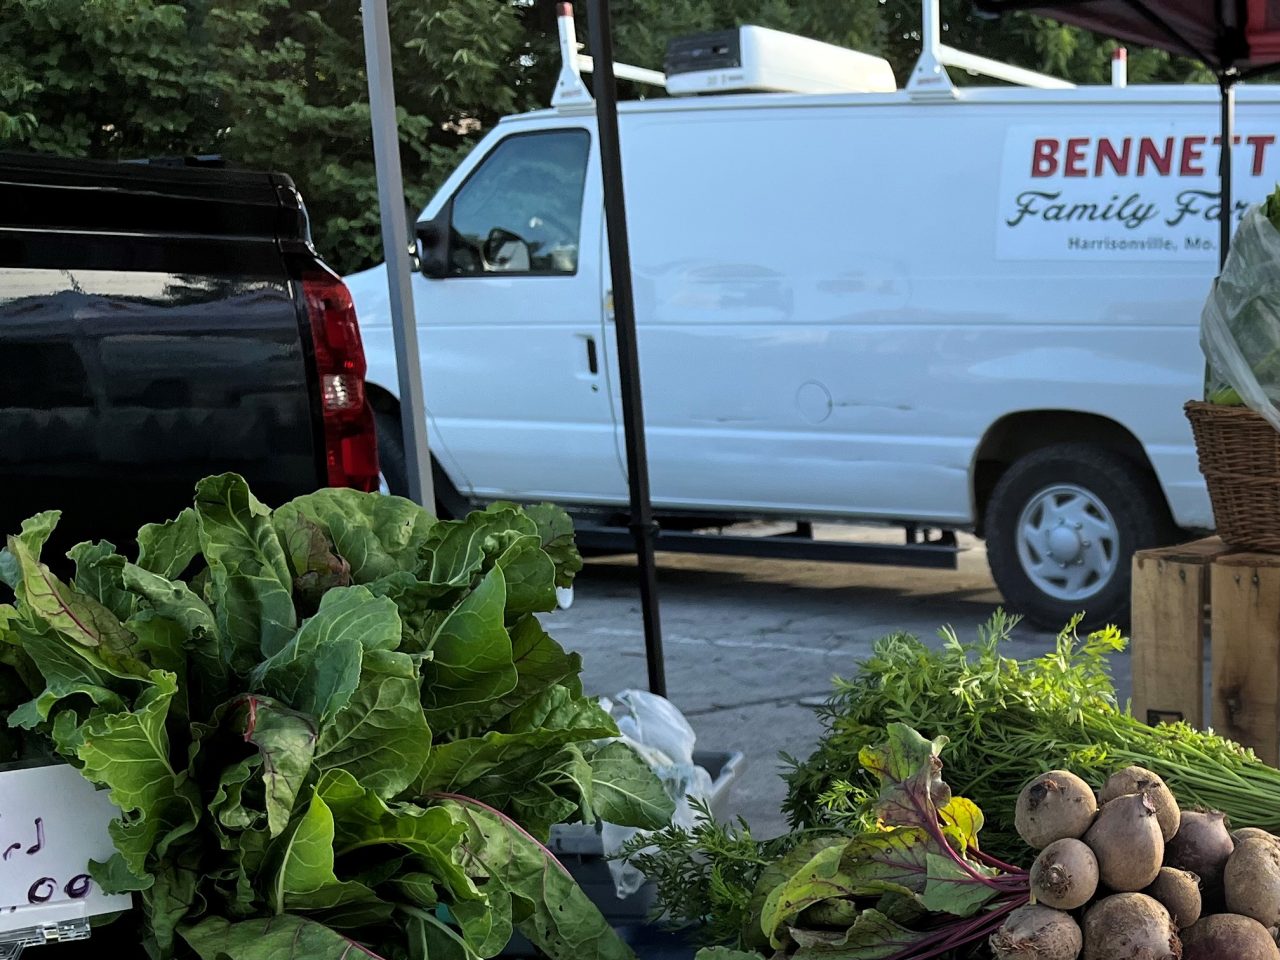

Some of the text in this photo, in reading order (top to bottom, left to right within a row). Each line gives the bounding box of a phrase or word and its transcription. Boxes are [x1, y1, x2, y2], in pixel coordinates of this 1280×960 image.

[1030, 135, 1276, 178] BENNETT
[1006, 190, 1249, 229] Family Far
[1067, 236, 1217, 251] Harrisonville, Mo.
